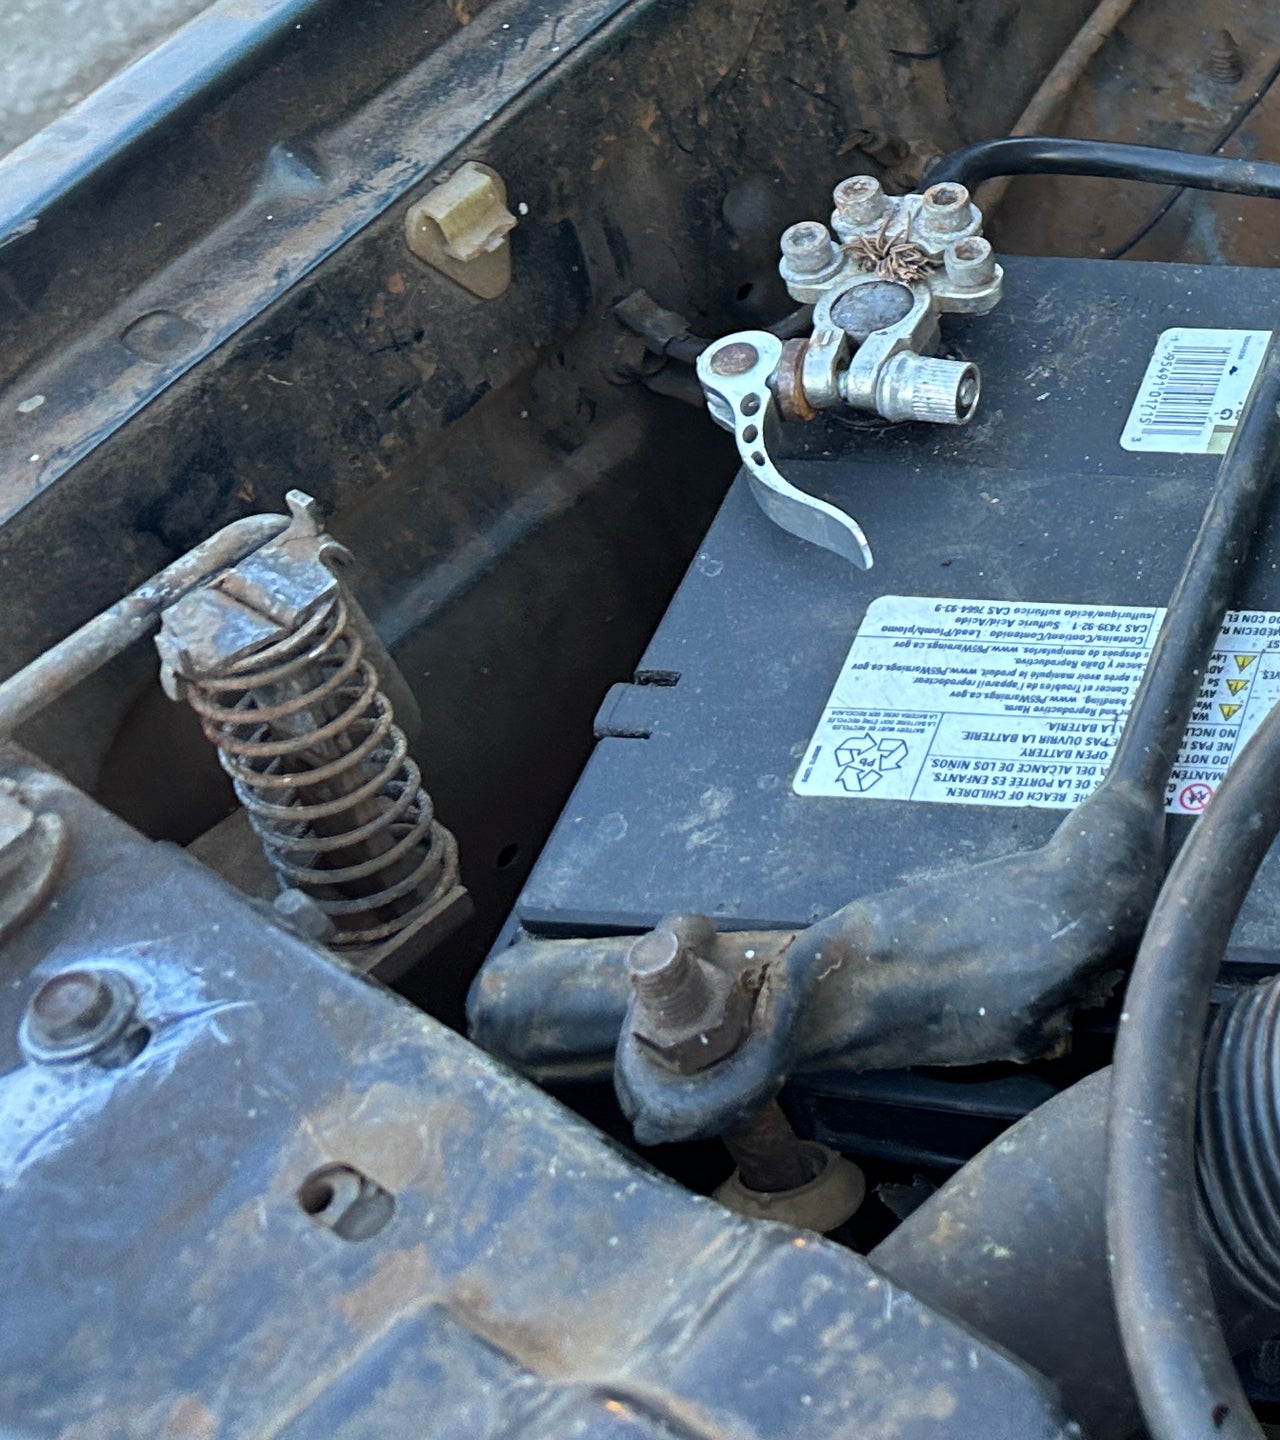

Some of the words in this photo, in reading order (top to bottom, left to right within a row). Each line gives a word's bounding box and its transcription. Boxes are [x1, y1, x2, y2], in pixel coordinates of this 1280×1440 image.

[986, 606, 1011, 615] CAS
[952, 616, 1016, 627] Acid/Acide
[1225, 613, 1239, 622] EL
[1241, 614, 1266, 623] CON
[1016, 619, 1061, 629] Sulfuric
[1123, 623, 1148, 633] CAS
[878, 623, 981, 638] Lead/Plomb/plomo
[1086, 649, 1100, 658] de
[1075, 673, 1101, 682] avoir
[1024, 682, 1038, 691] de
[1037, 682, 1082, 692] Troubles
[1093, 685, 1129, 694] Cancer
[1031, 704, 1097, 716] Reproductive
[958, 730, 1019, 742] BATTERIE.
[1218, 728, 1237, 737] NO
[1019, 734, 1036, 743] LA
[1037, 734, 1082, 745] OUVRIR
[1189, 741, 1213, 750] PAS
[1214, 742, 1233, 751] NE
[1017, 747, 1073, 758] BATTERY.
[1074, 749, 1108, 759] OPEN
[857, 757, 876, 766] Pb
[1183, 754, 1209, 763] NOT
[1211, 755, 1229, 764] DO
[926, 758, 971, 771] NIÑOS.
[972, 761, 996, 771] LOS
[997, 762, 1015, 772] DE
[1015, 763, 1072, 775] ALCANCE
[1073, 765, 1096, 775] DEL
[928, 771, 989, 784] ENFANTS.
[989, 775, 1007, 785] ES
[1055, 778, 1072, 788] LA
[1072, 779, 1091, 789] DE
[943, 787, 1007, 799] CHILDREN.
[1007, 790, 1024, 800] OF
[1025, 791, 1067, 801] REACH
